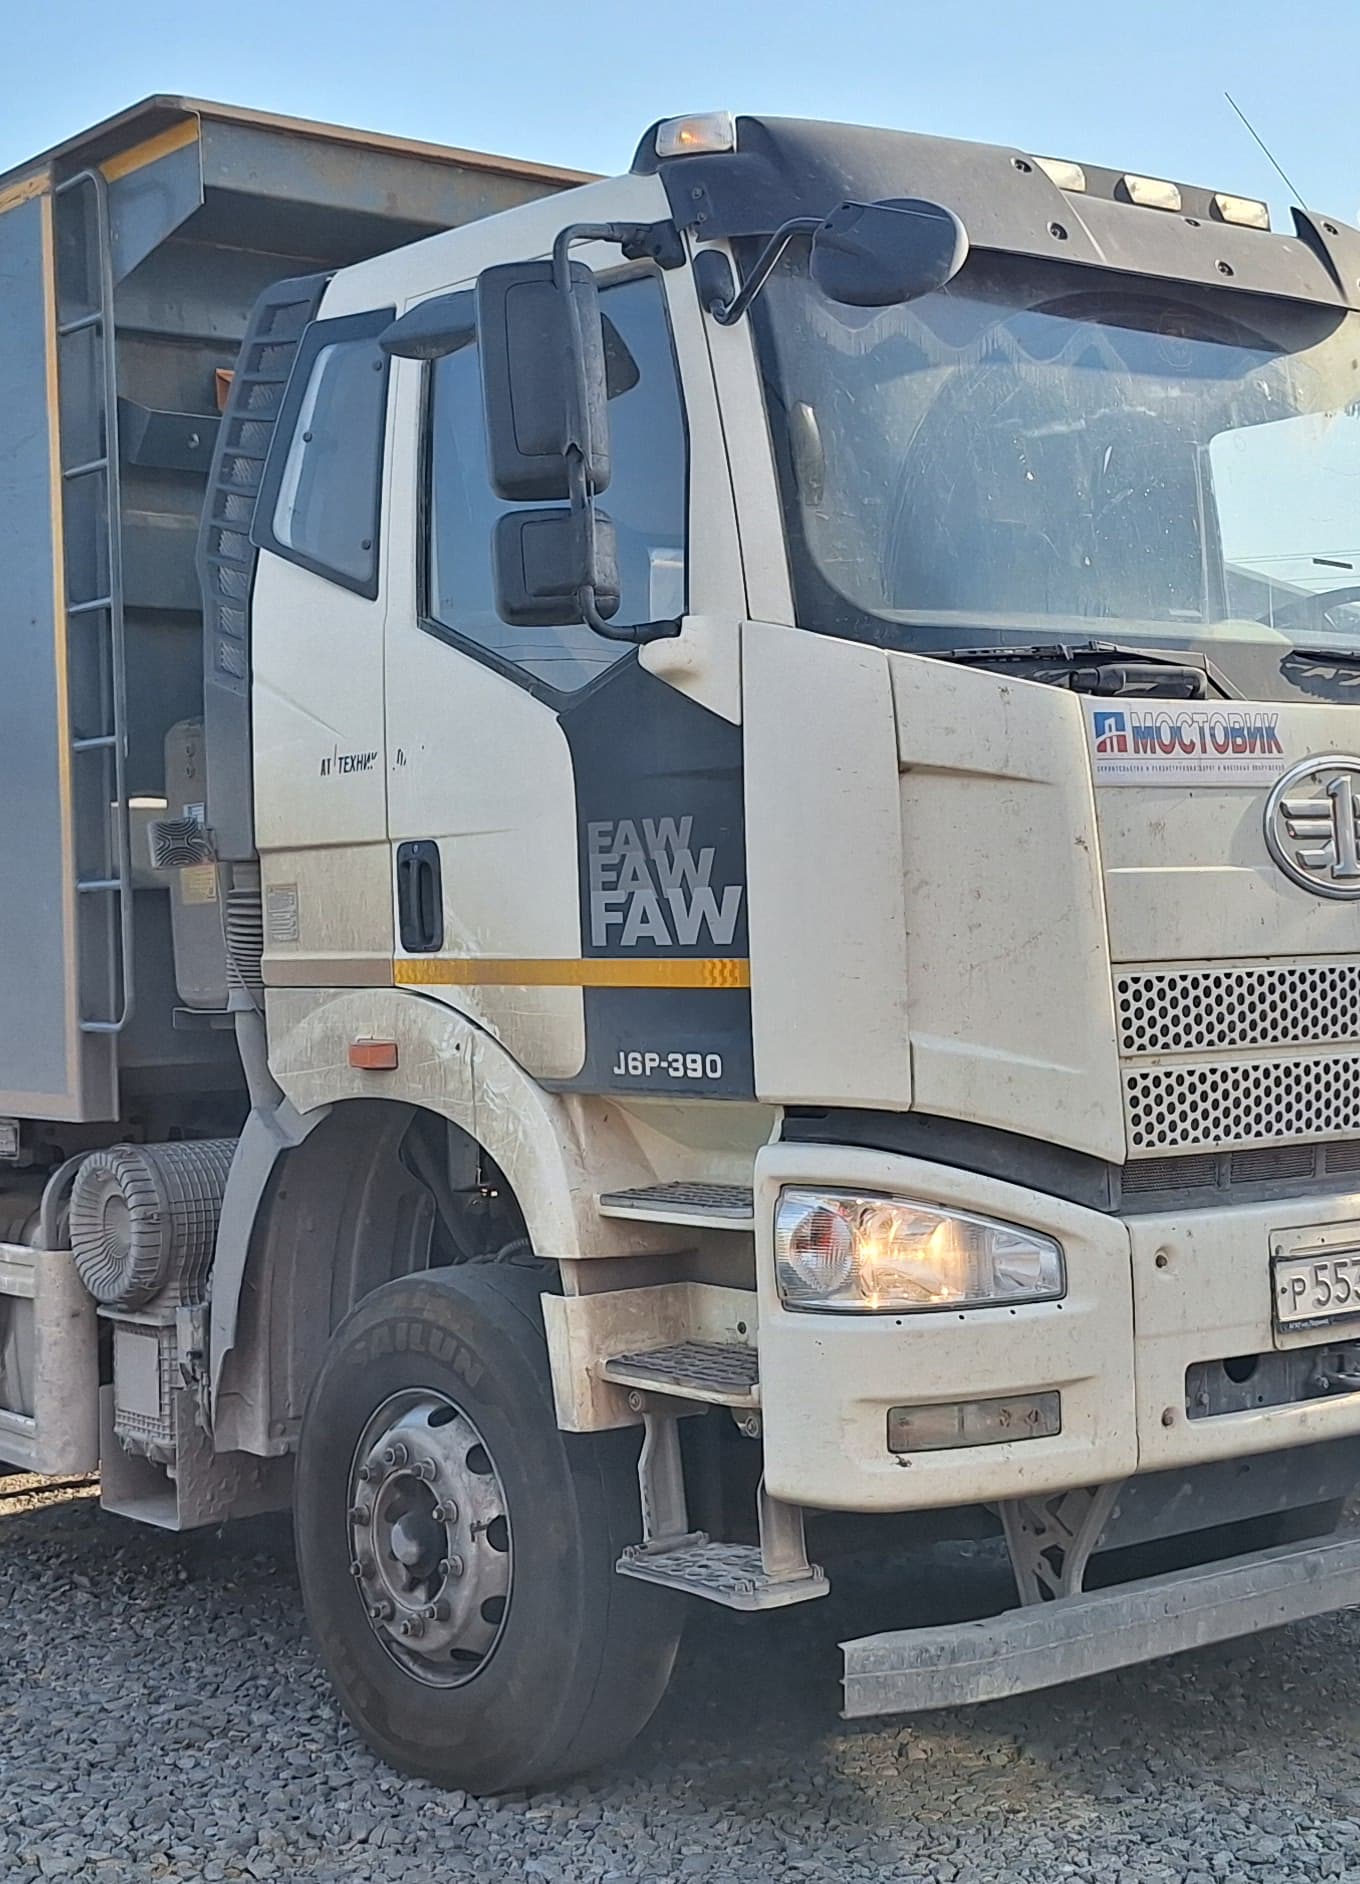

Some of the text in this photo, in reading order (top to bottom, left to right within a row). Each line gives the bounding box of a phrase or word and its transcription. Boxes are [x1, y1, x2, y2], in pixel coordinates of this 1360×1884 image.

[1129, 711, 1284, 755] МОСТОВИК
[587, 815, 694, 860] FAW
[590, 847, 716, 900] FAW
[591, 885, 744, 947] FAW
[612, 1051, 723, 1080] J6P-390
